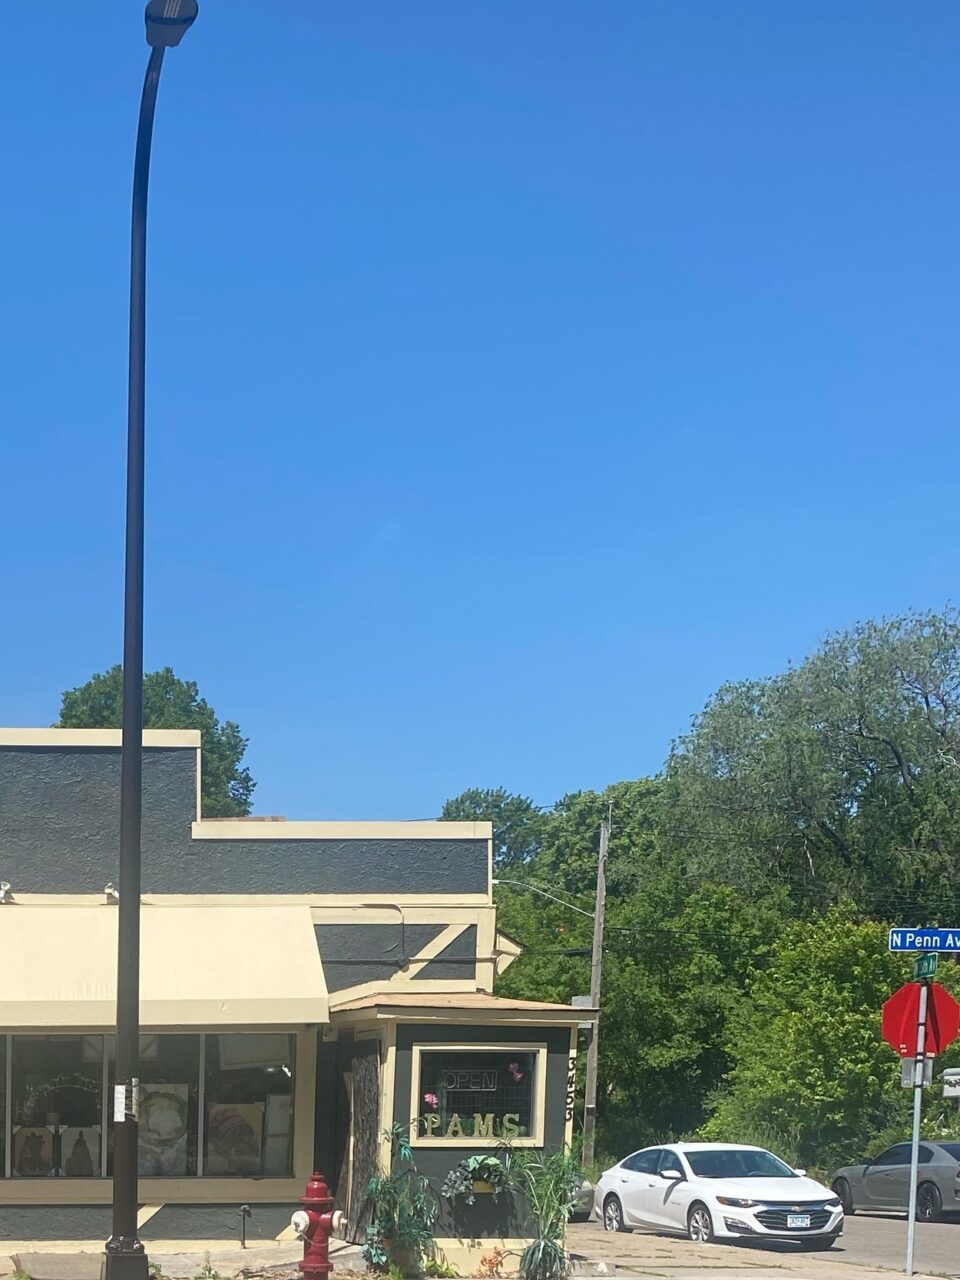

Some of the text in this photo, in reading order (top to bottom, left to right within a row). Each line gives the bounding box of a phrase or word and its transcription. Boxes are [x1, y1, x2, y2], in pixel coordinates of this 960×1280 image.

[892, 933, 902, 947] N
[906, 933, 941, 948] Penn
[446, 1071, 496, 1090] OPEN
[423, 1112, 521, 1138] PAMS
